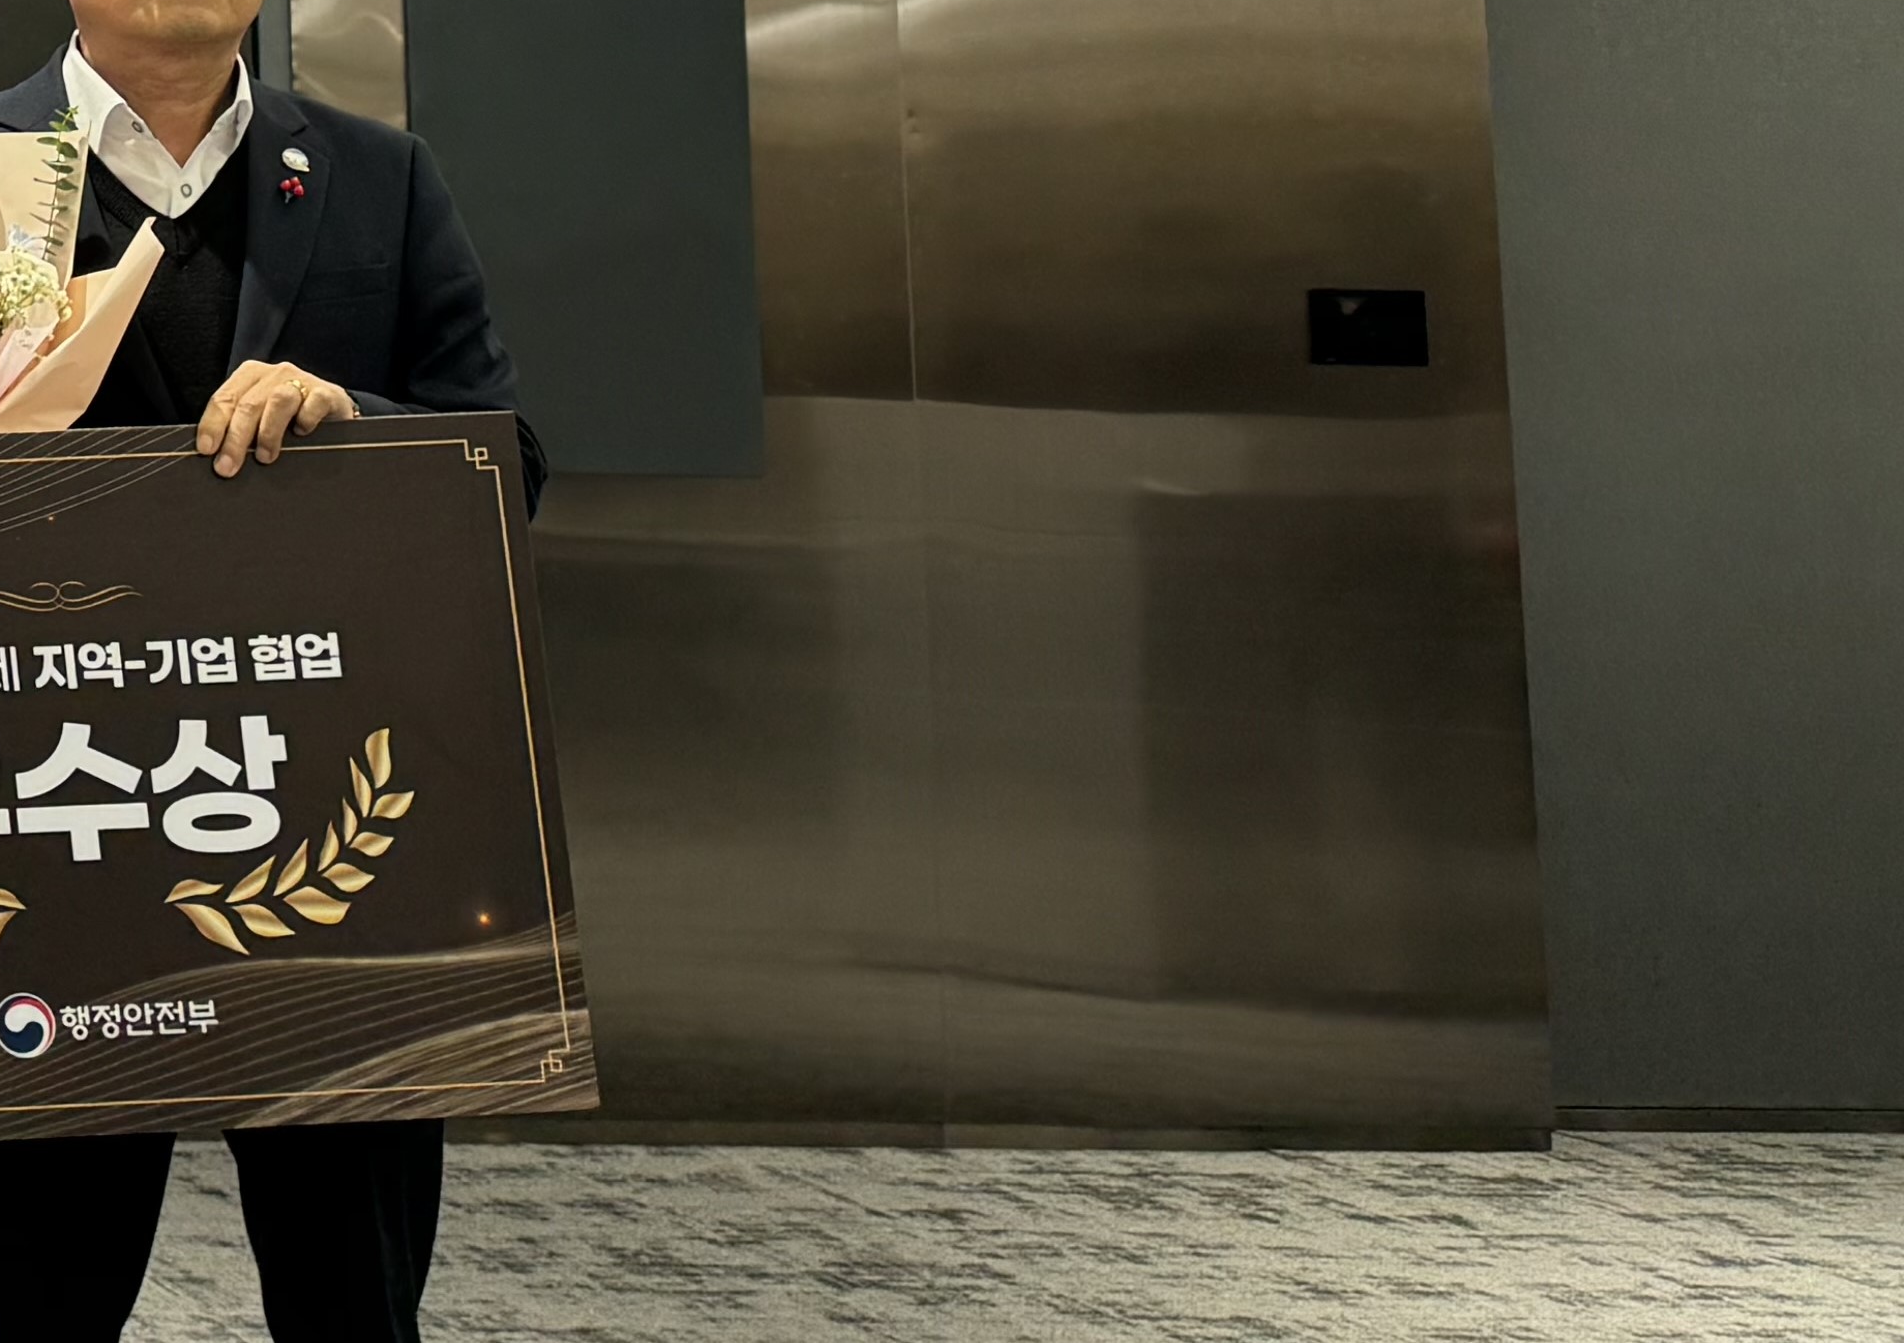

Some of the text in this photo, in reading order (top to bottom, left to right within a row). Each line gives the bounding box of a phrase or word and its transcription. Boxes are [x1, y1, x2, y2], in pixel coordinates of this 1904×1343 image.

[32, 636, 238, 690] 지역-기업
[247, 632, 343, 681] 협업
[59, 999, 219, 1041] 행정안전부
